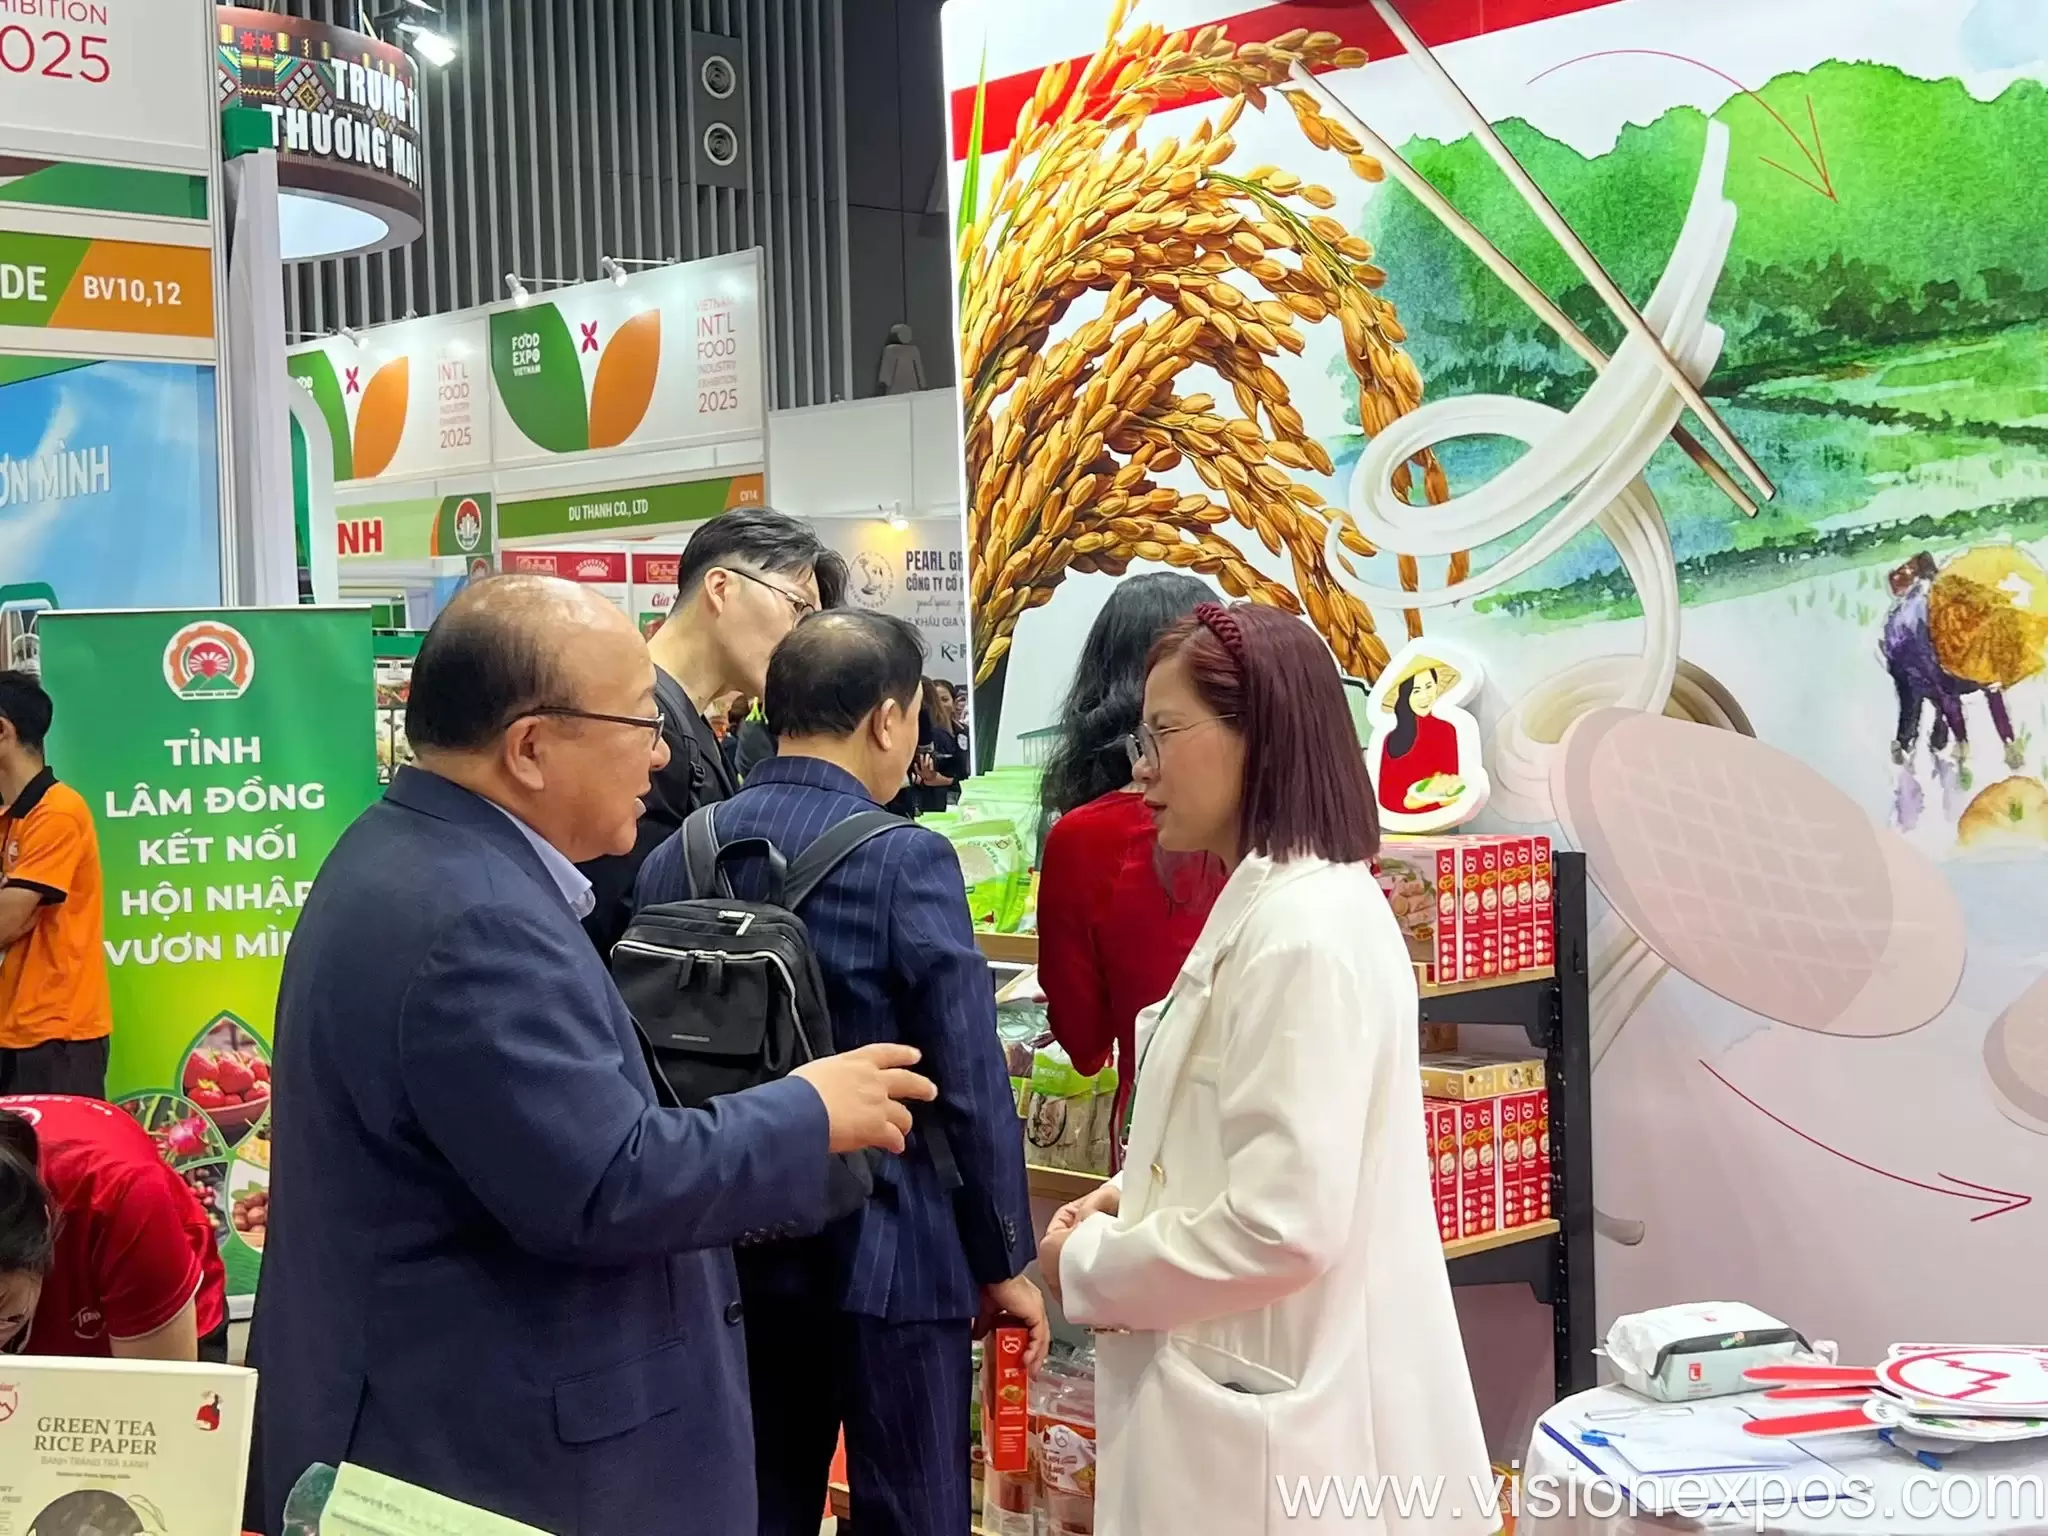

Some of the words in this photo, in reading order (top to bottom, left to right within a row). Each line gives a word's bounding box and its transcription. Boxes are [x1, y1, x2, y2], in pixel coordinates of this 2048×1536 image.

[331, 58, 406, 122] TRUNG
[262, 103, 386, 169] THƯƠNG
[83, 274, 182, 308] BV10,12
[511, 332, 540, 350] FOOD
[697, 338, 736, 360] FOOD
[512, 348, 541, 366] EXPO
[438, 383, 470, 400] FOOD
[699, 388, 738, 413] 2025
[440, 427, 472, 449] 2025
[38, 440, 110, 501] MÌNH
[568, 505, 581, 521] DU
[582, 502, 613, 519] THANH
[632, 498, 649, 515] LTD
[906, 550, 945, 571] PEARL
[906, 573, 930, 591] CÔNG
[933, 577, 943, 592] TY
[164, 728, 261, 766] TỈNH
[105, 782, 192, 818] LÂM
[204, 775, 325, 813] ĐỒNG
[139, 828, 214, 866] KẾT
[227, 823, 297, 862] NỐI
[121, 880, 192, 921] HỘI
[104, 932, 221, 966] VƯƠN
[37, 1416, 110, 1435] GREEN
[114, 1420, 157, 1437] TEA
[34, 1435, 85, 1452] RICE
[89, 1438, 157, 1456] PAPER
